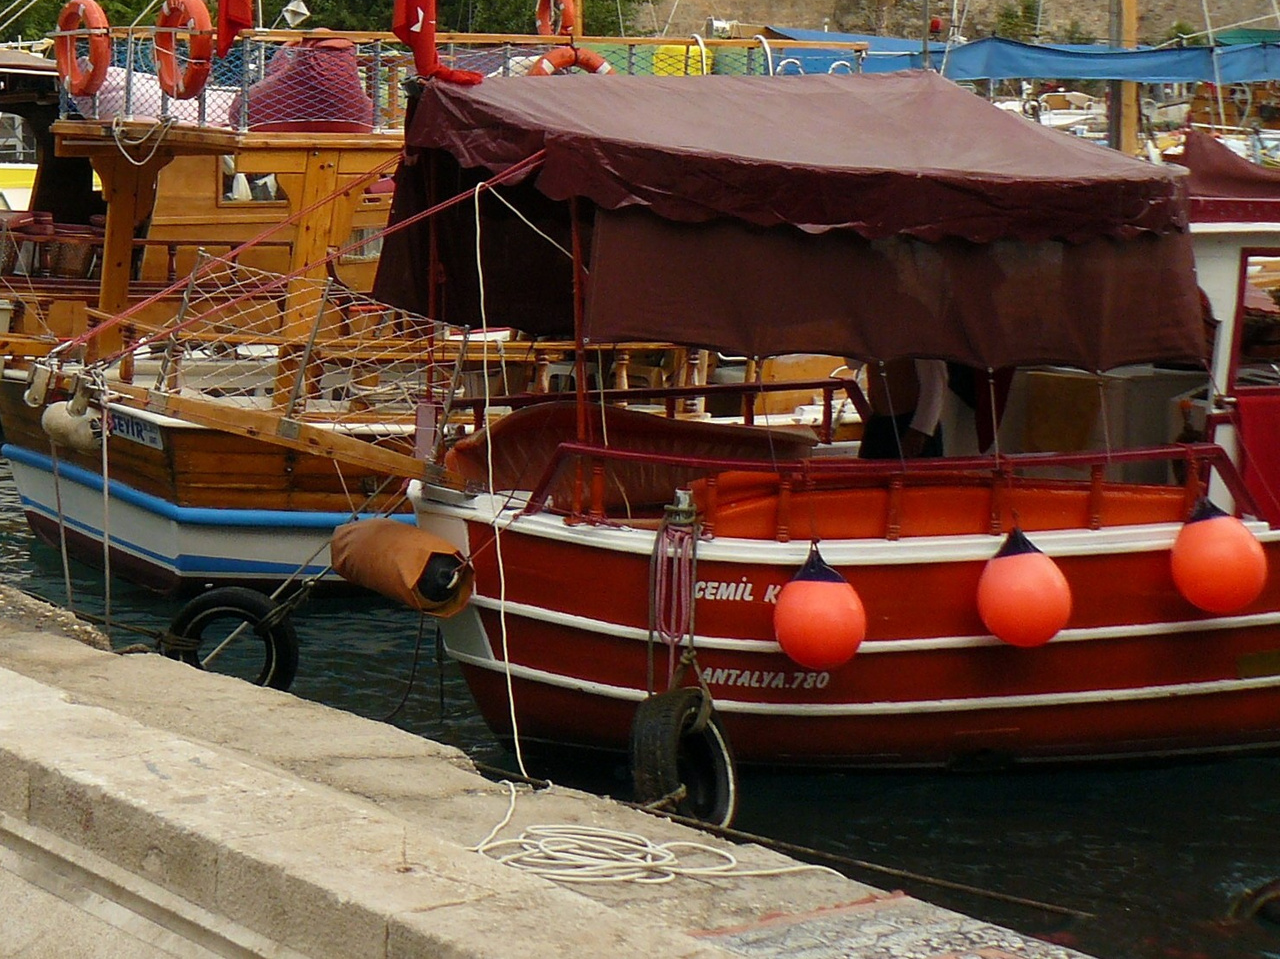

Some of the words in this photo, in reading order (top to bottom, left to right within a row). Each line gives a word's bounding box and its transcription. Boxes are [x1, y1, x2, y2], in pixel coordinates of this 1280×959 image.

[694, 576, 754, 602] CEMİL
[763, 584, 782, 604] K
[701, 667, 830, 689] ANTALYA.780
